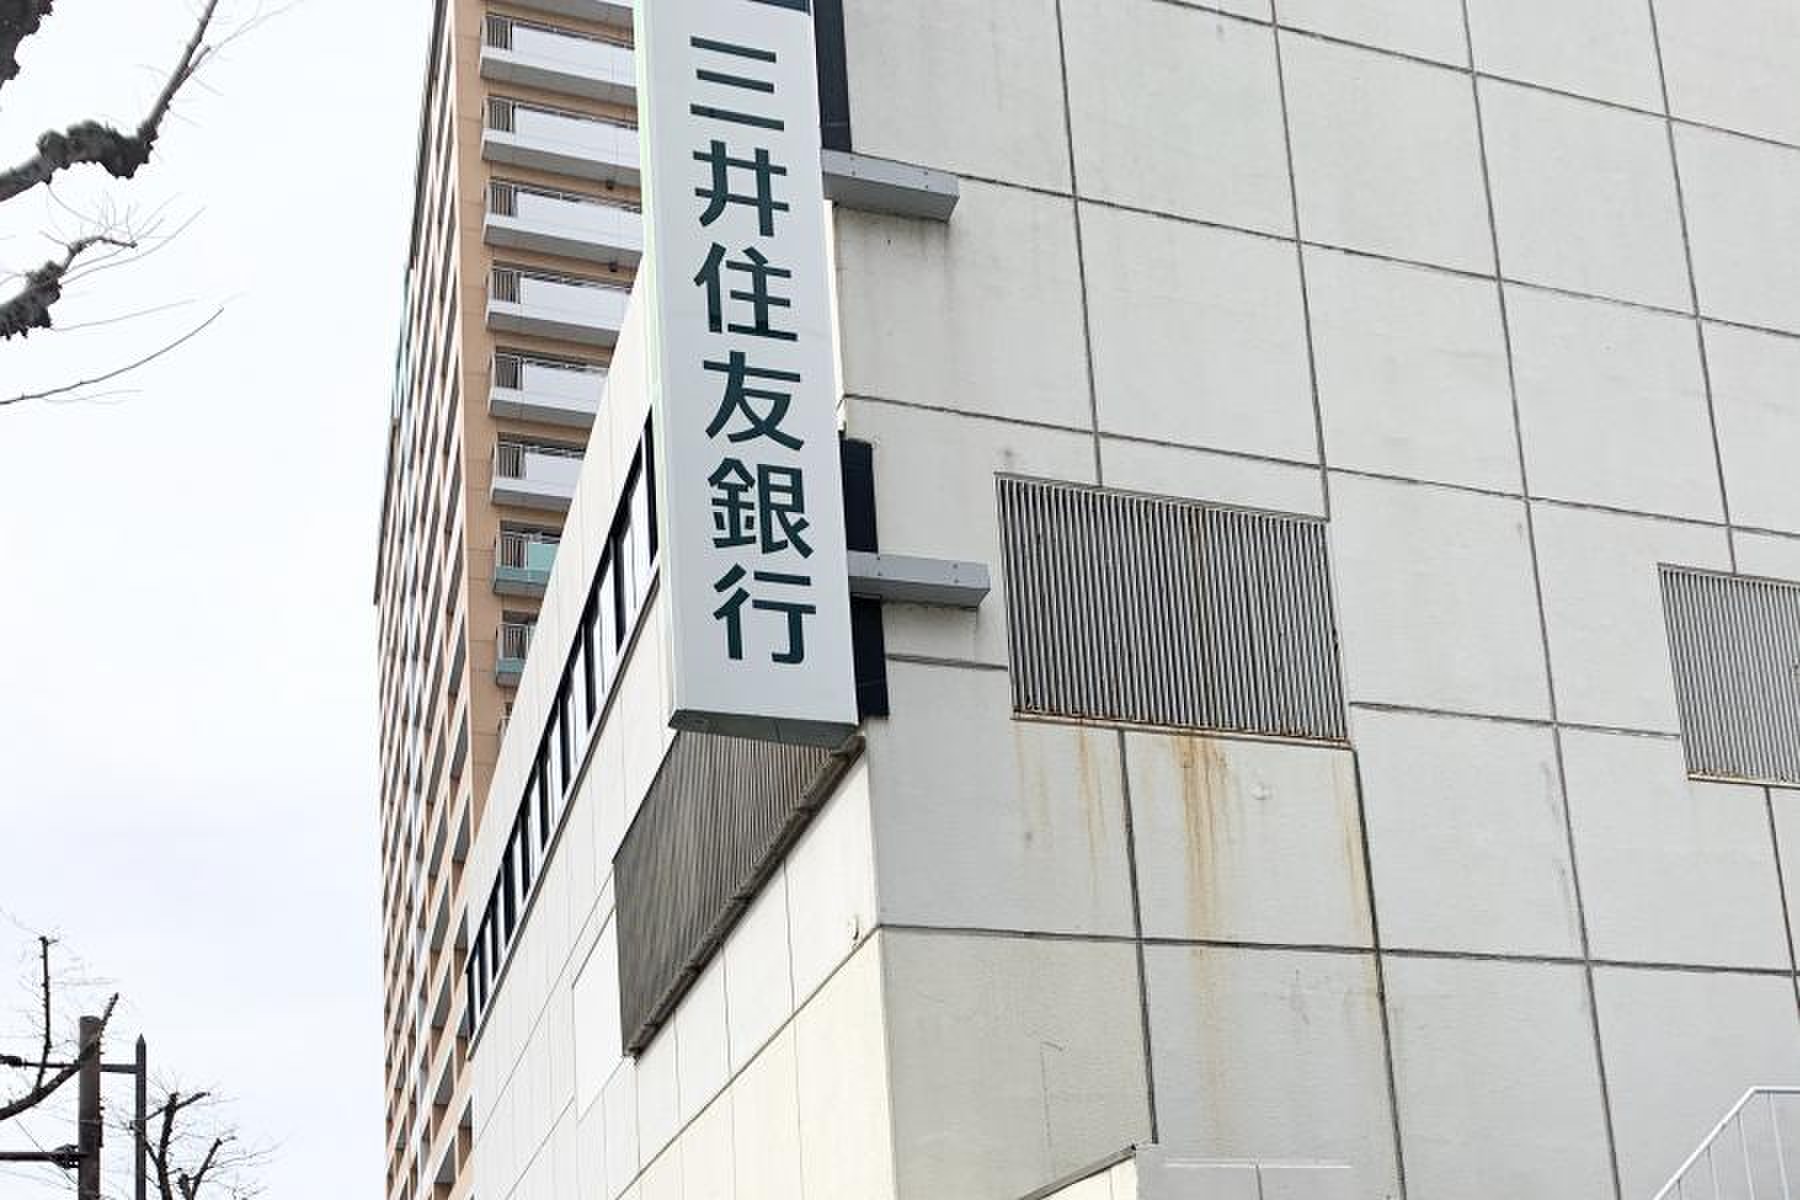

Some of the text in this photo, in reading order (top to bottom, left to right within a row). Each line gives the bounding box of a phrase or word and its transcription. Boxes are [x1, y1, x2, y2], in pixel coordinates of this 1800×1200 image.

[690, 35, 817, 665] 三井住友銀行
